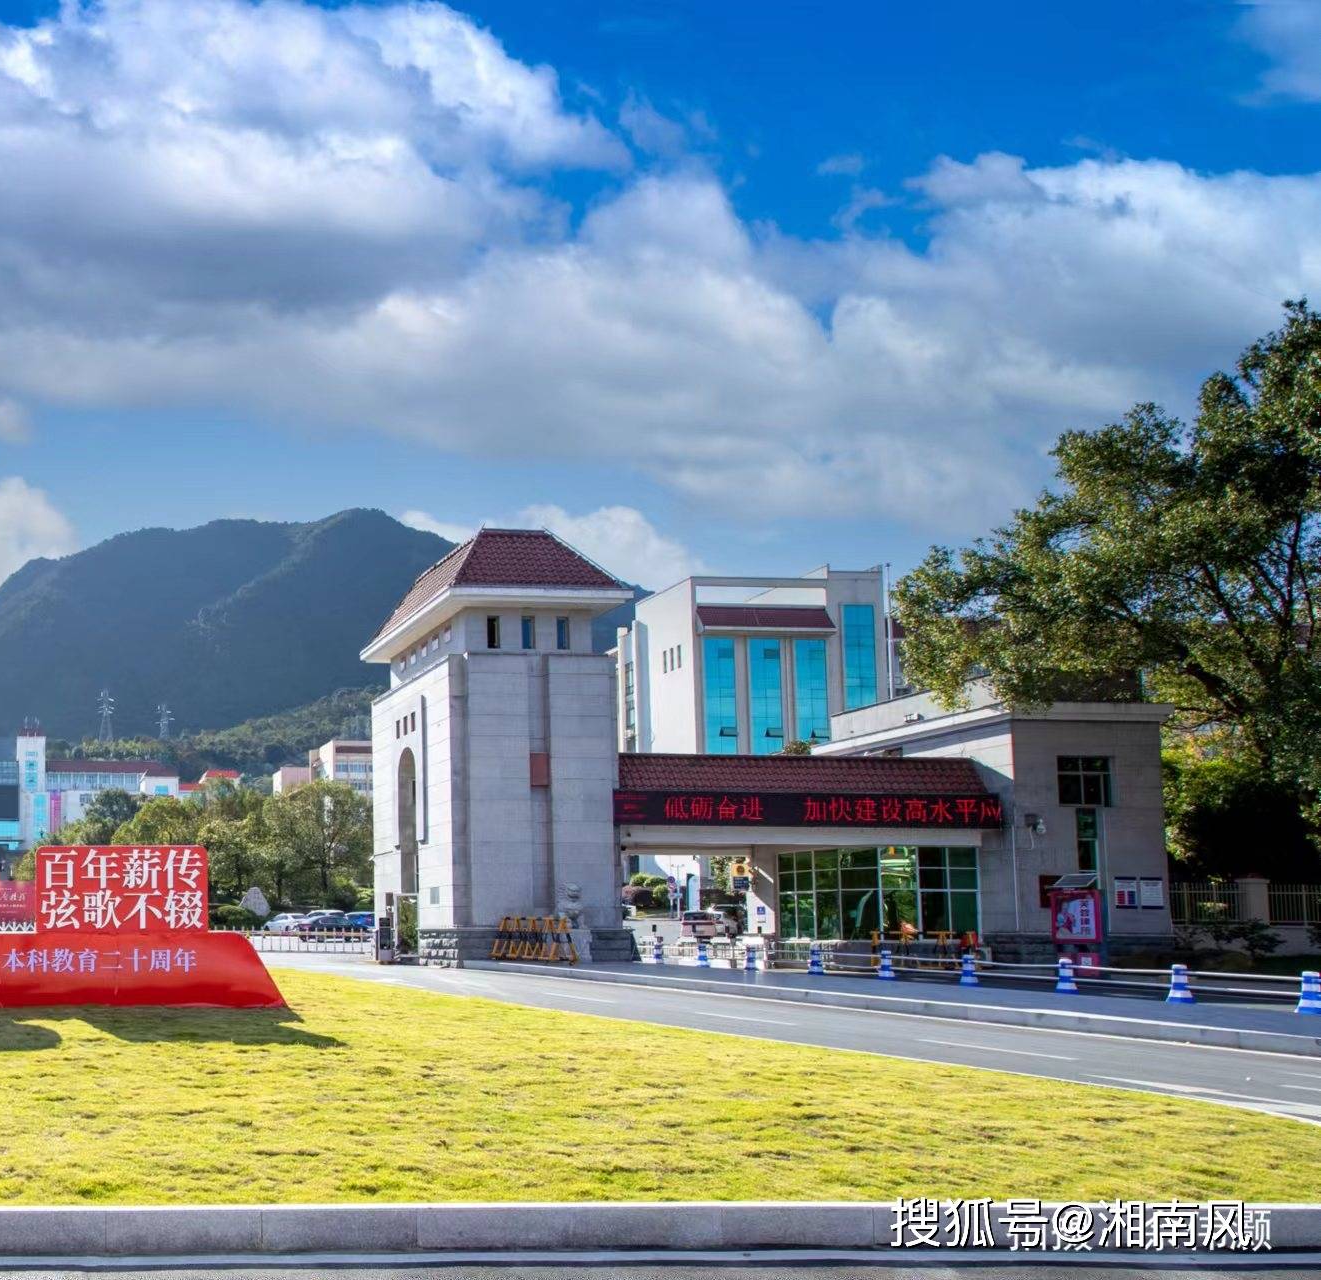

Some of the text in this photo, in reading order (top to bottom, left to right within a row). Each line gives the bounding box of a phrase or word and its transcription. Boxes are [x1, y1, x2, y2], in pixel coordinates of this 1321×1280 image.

[663, 796, 765, 820] 砥砺奋进
[40, 849, 203, 889] 百年薪传
[40, 889, 204, 930] 弦歌不辍
[2, 948, 197, 973] 本科教育二十周年
